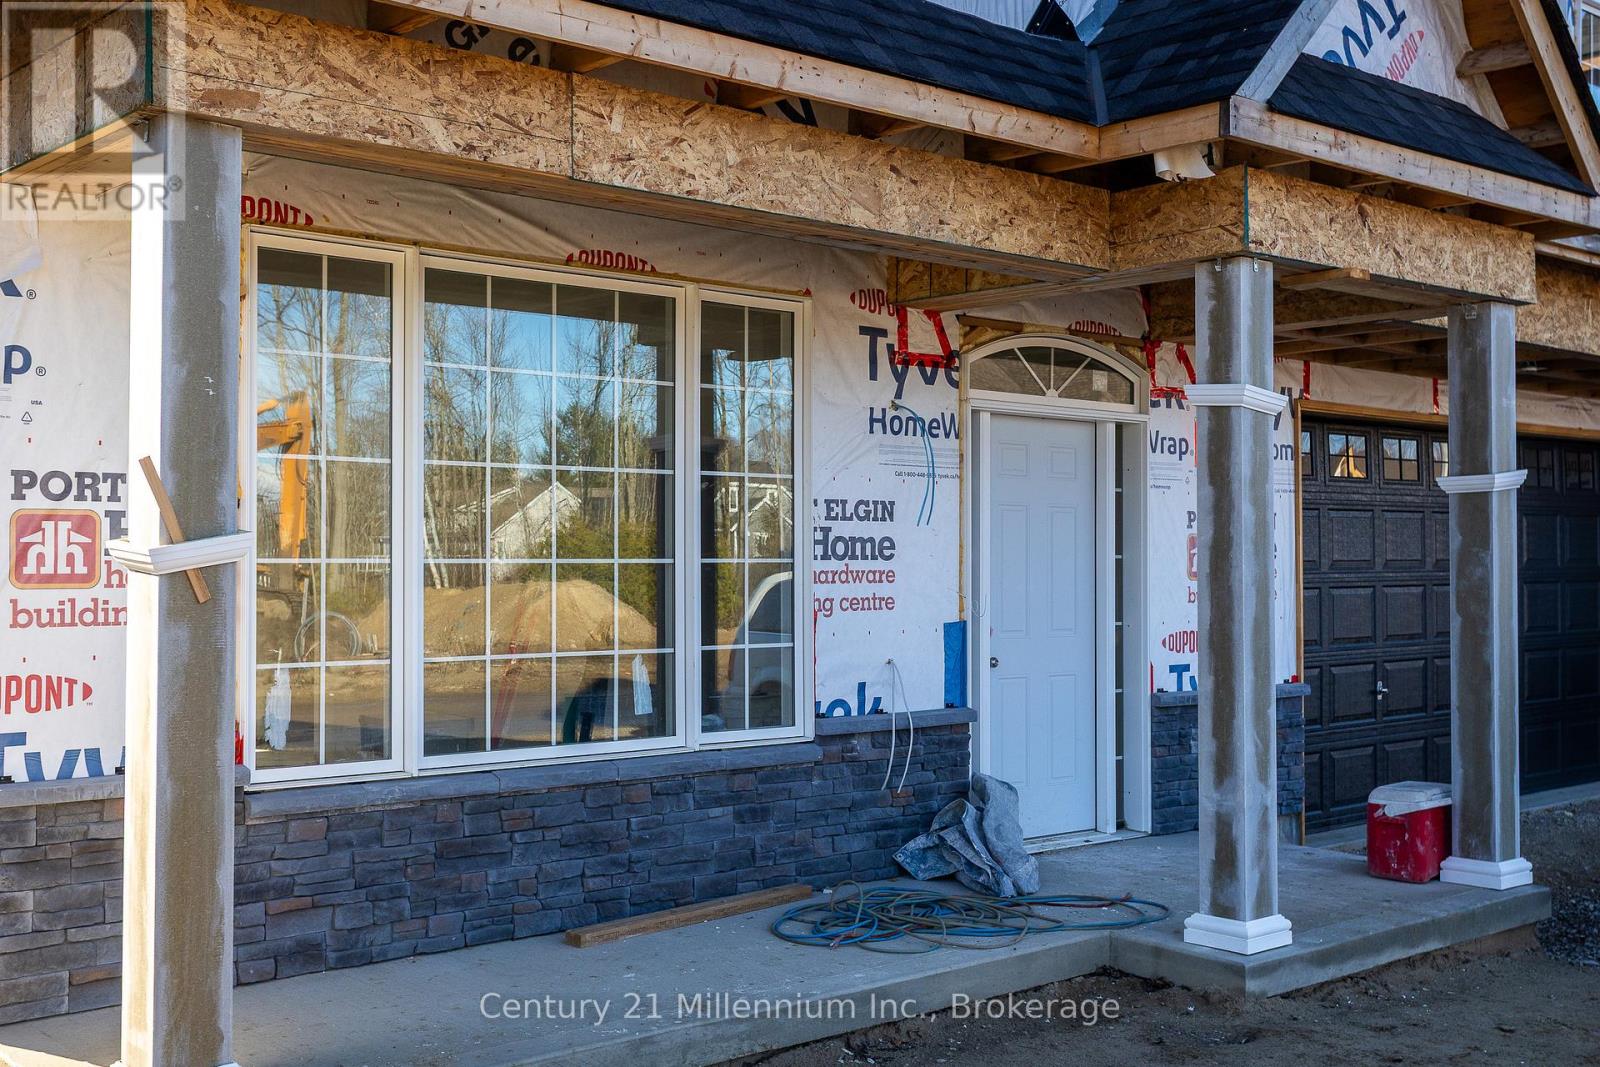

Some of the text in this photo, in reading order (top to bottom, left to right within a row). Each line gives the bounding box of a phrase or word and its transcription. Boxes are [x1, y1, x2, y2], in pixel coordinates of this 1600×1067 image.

[11, 470, 127, 502] PORT
[824, 499, 895, 522] ELGIN
[813, 526, 896, 561] Home
[839, 593, 896, 612] centre
[0, 674, 78, 715] PONT
